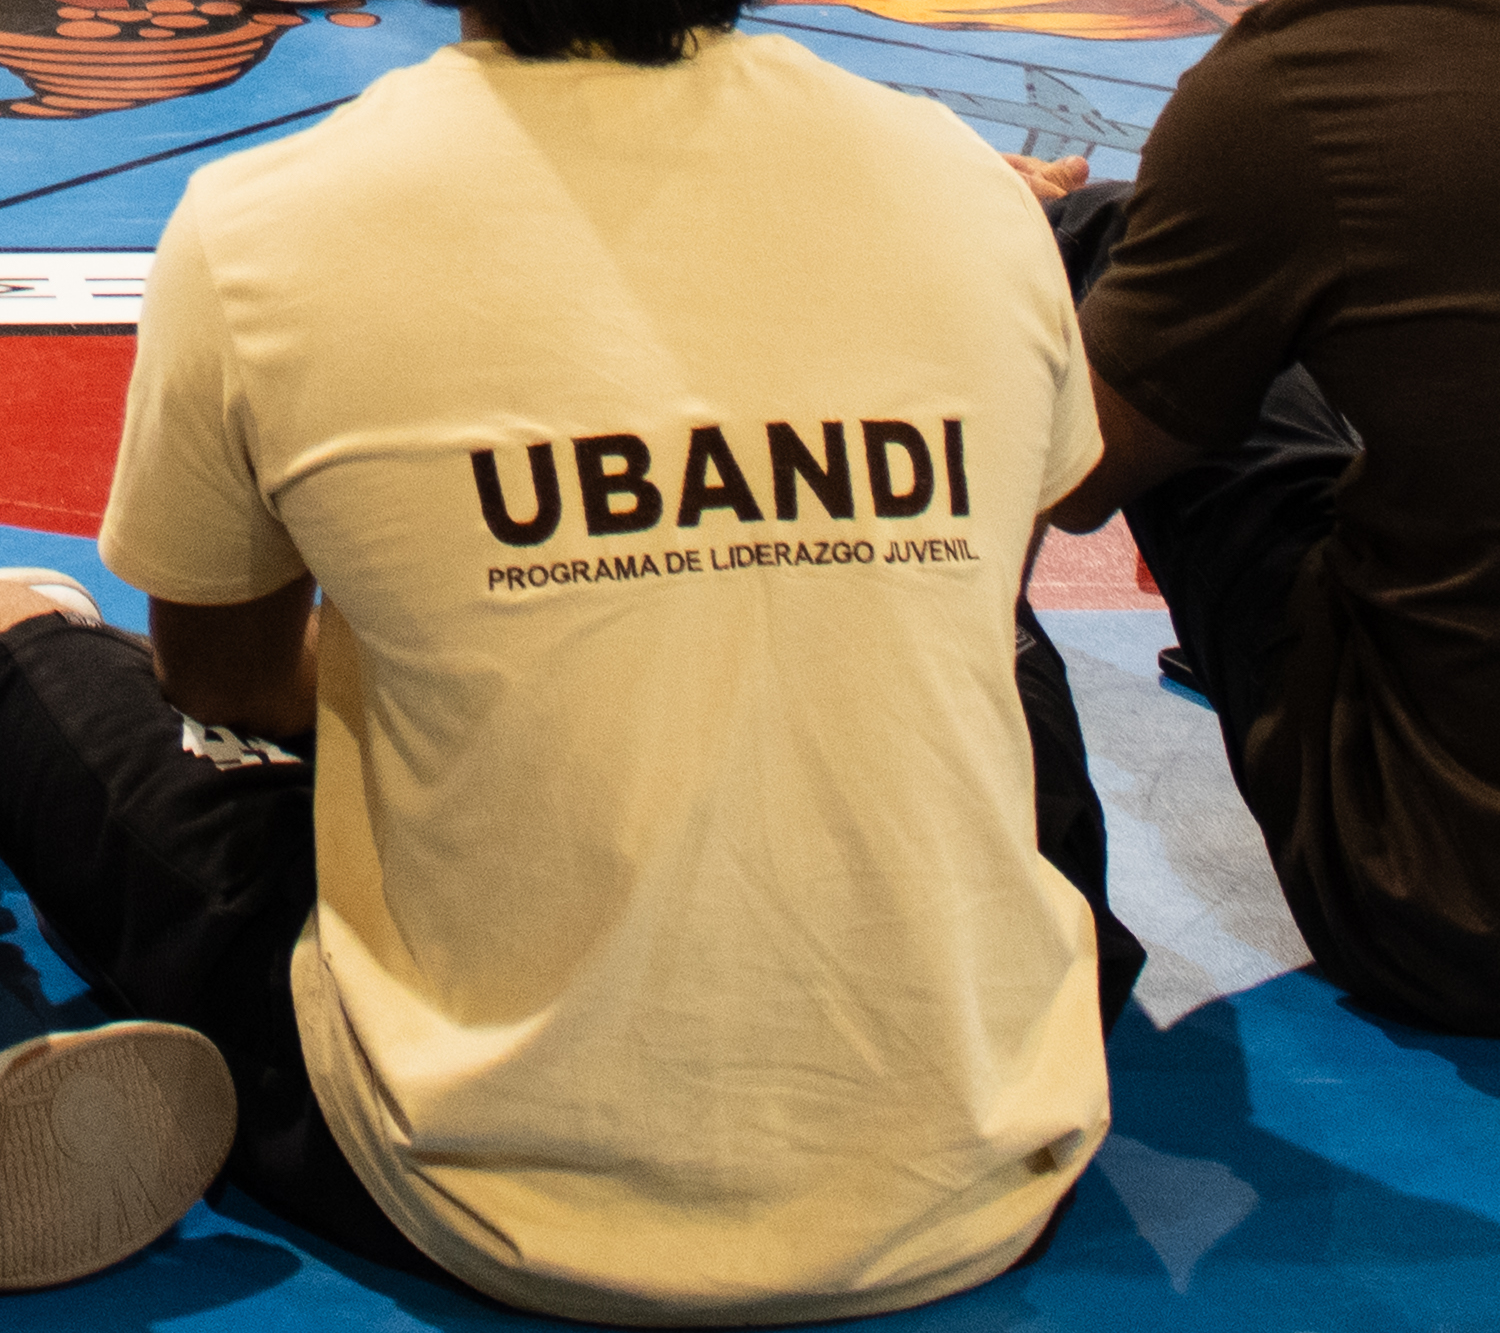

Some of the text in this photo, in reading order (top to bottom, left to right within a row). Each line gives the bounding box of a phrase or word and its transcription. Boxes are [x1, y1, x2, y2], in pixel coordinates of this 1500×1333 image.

[469, 418, 971, 548] UBANDI
[488, 537, 980, 592] PROGRAMA DE LIDERAZGO JUVENIL
